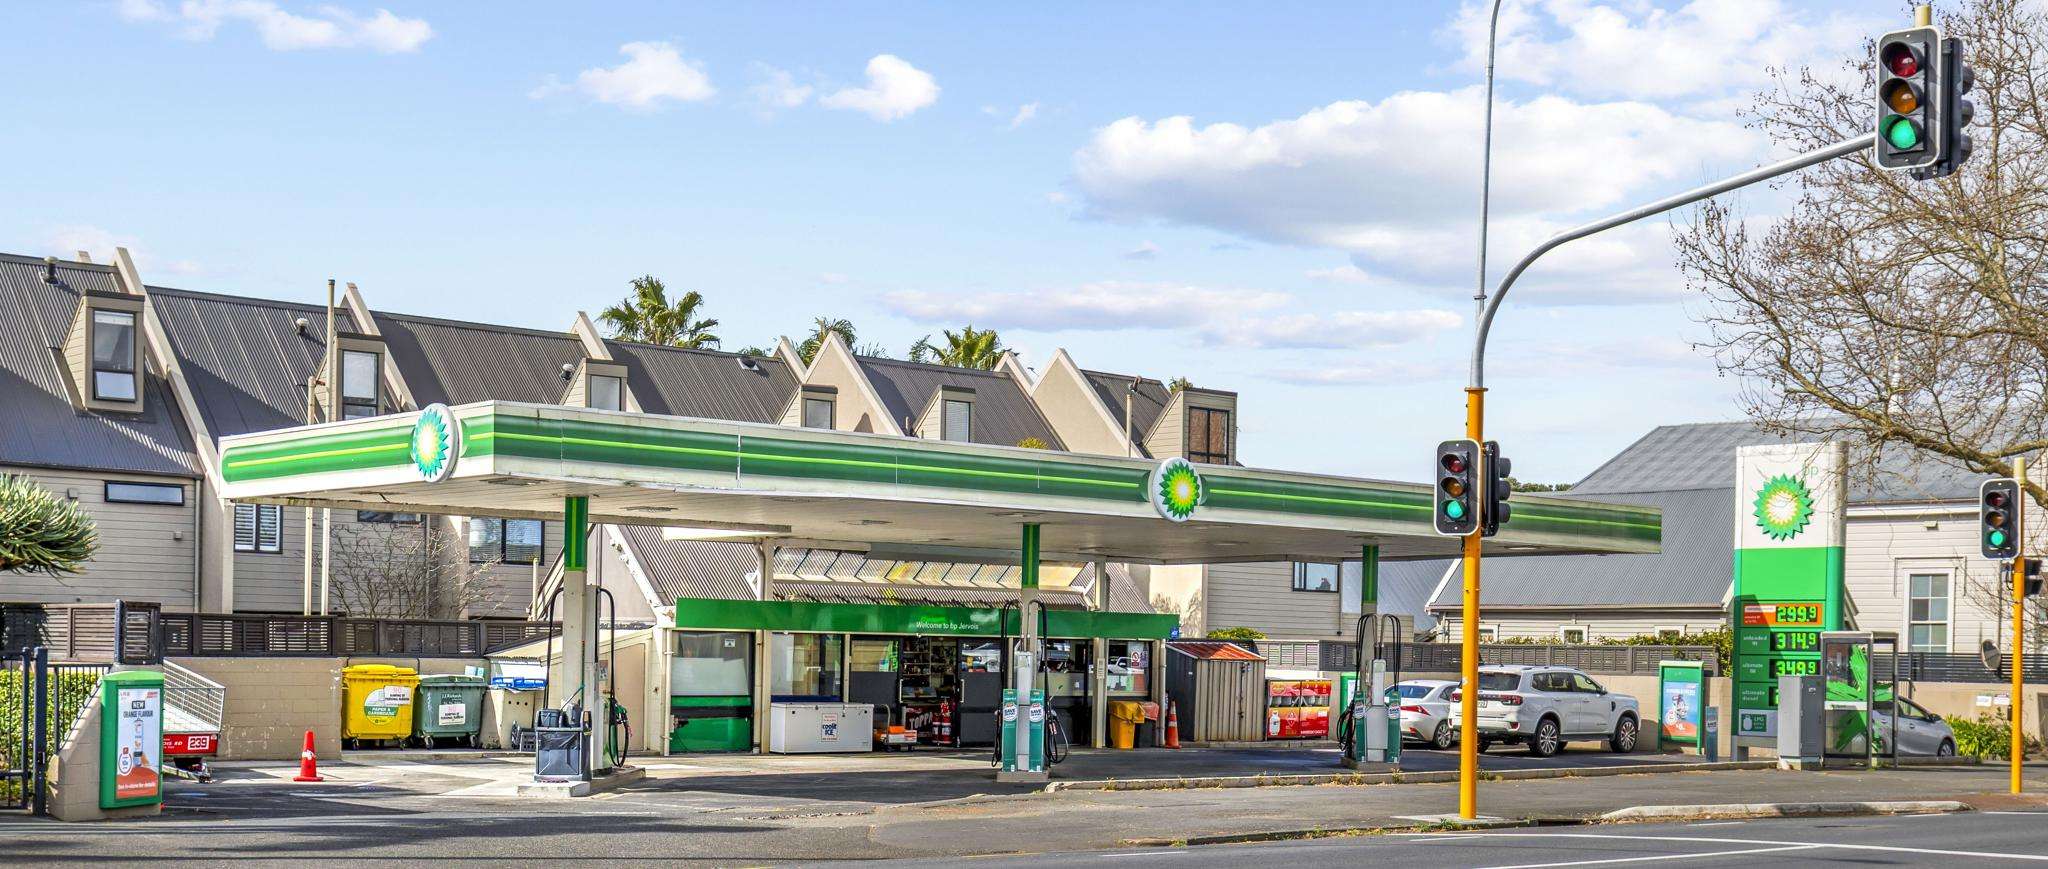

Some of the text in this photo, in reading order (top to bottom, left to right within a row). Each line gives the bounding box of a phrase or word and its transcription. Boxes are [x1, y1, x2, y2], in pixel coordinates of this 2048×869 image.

[1777, 606, 1817, 622] 299.9
[916, 621, 942, 629] Welcome
[950, 622, 957, 630] bp
[958, 622, 979, 630] Jervois
[1776, 632, 1817, 649] 314.9
[190, 737, 208, 748] 239
